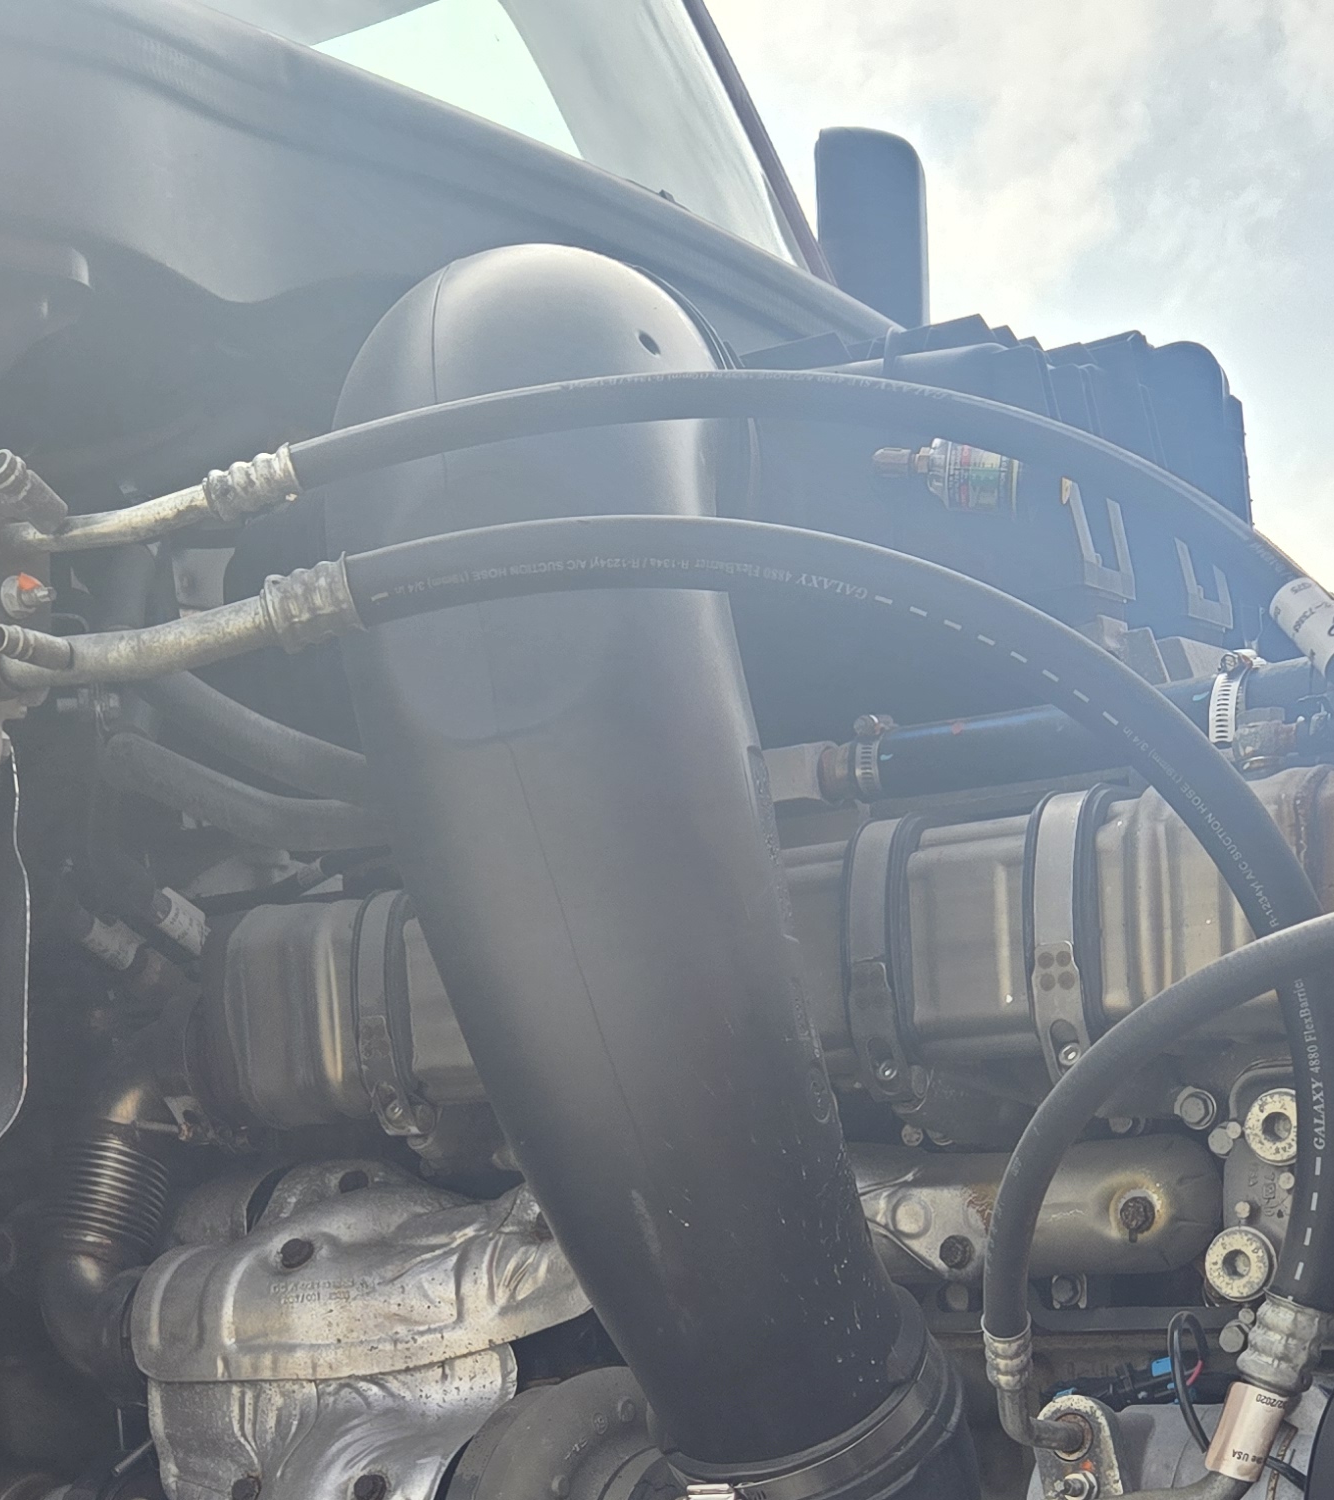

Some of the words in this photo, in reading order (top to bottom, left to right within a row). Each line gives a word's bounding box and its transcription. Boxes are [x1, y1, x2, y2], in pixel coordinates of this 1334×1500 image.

[470, 567, 507, 581] HOSE
[509, 560, 564, 576] SUCTION
[567, 559, 587, 571] A/C
[694, 559, 761, 577] FlexBarrier
[427, 570, 469, 587] (19mm)
[763, 566, 793, 583] 4880
[408, 580, 425, 592] 3/4
[795, 572, 868, 600] GALAXY
[1131, 734, 1149, 752] 3/4
[1148, 748, 1185, 785] (19mm)
[1180, 783, 1207, 814] HOSE
[1205, 811, 1243, 861] SUCTION
[1238, 860, 1254, 880] A/C
[1249, 881, 1280, 929] R-1234yf
[1305, 1044, 1322, 1074] 4880
[1310, 1076, 1326, 1150] GALAXY
[1232, 1448, 1250, 1462] USA
